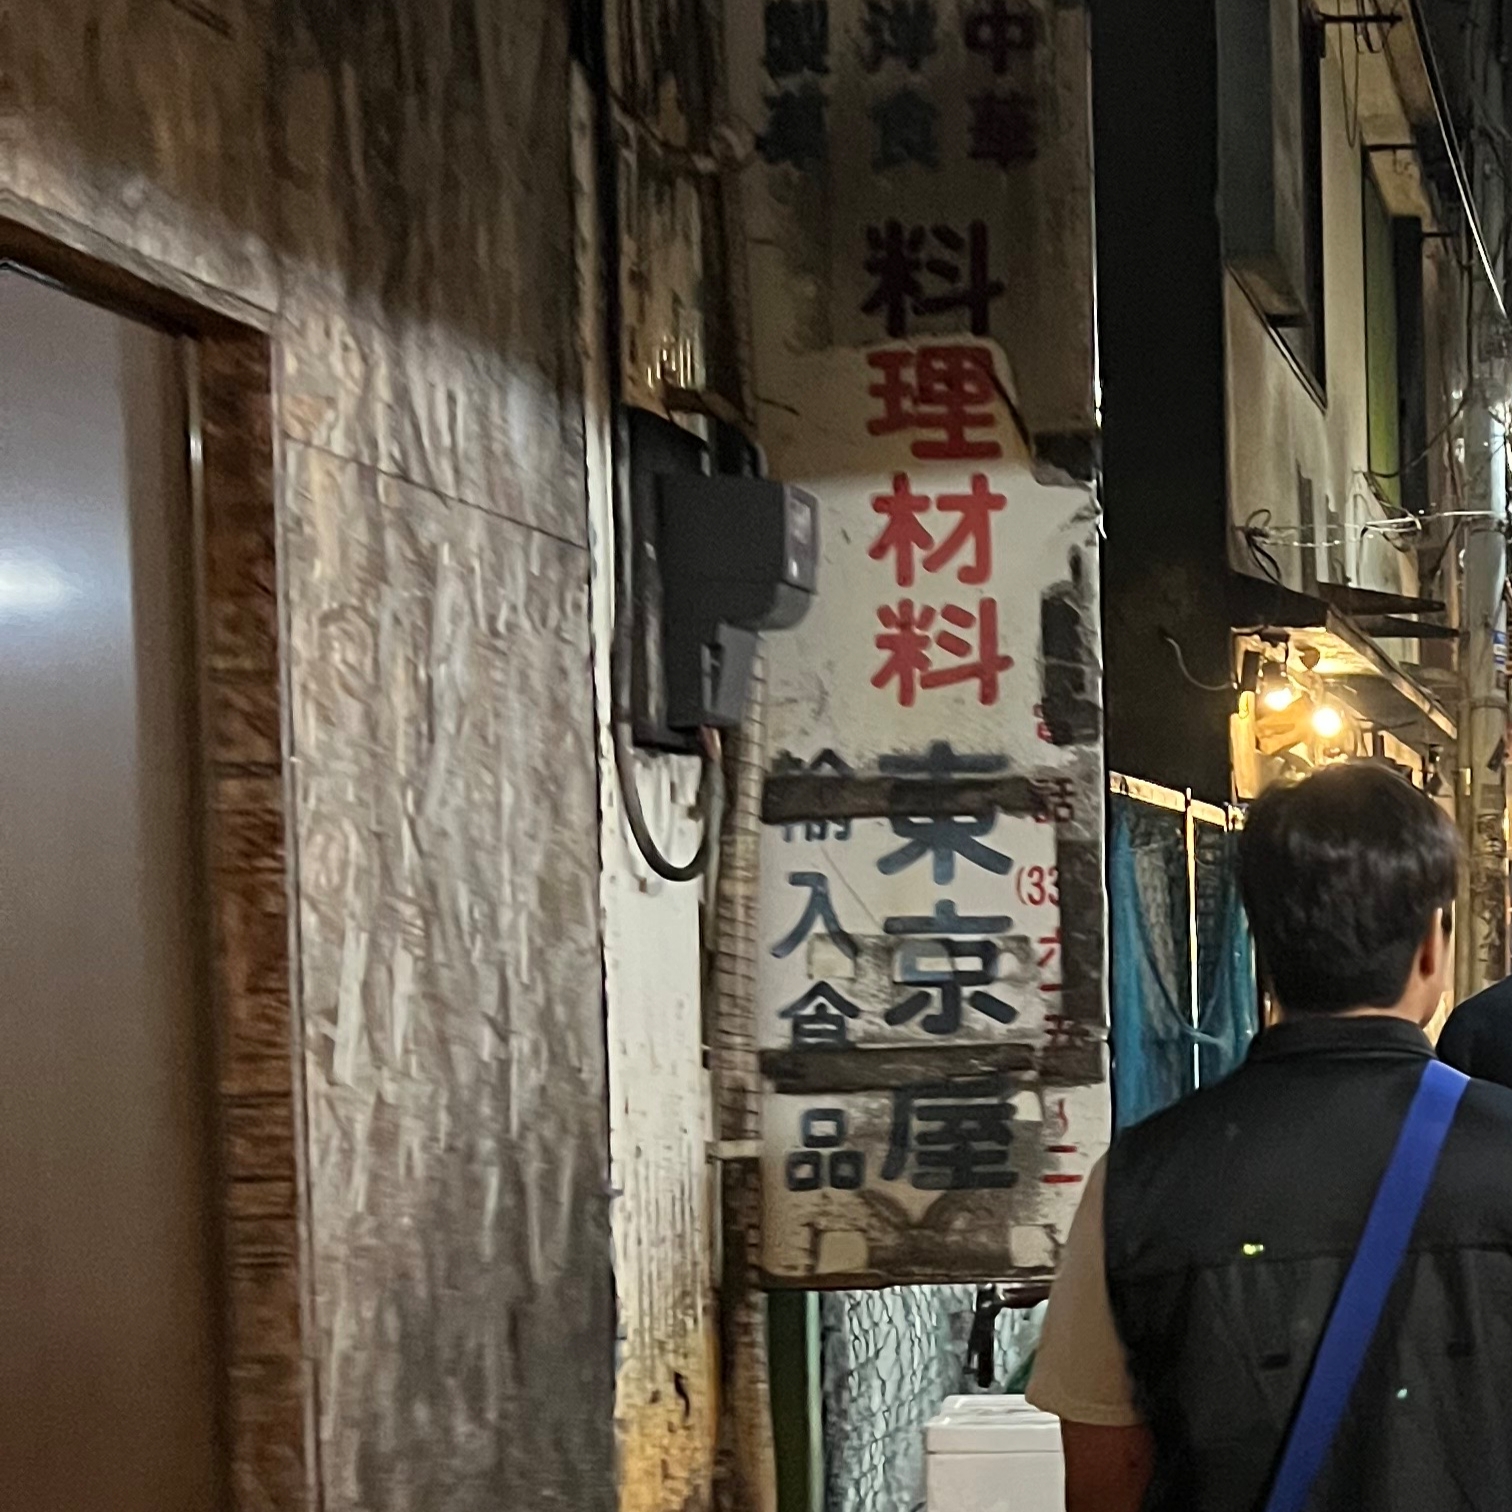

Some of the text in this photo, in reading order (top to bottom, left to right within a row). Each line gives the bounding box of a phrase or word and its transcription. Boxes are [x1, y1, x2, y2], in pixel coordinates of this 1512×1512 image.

[862, 218, 1014, 707] 料理材料
[876, 740, 1020, 1190] 東京屋
